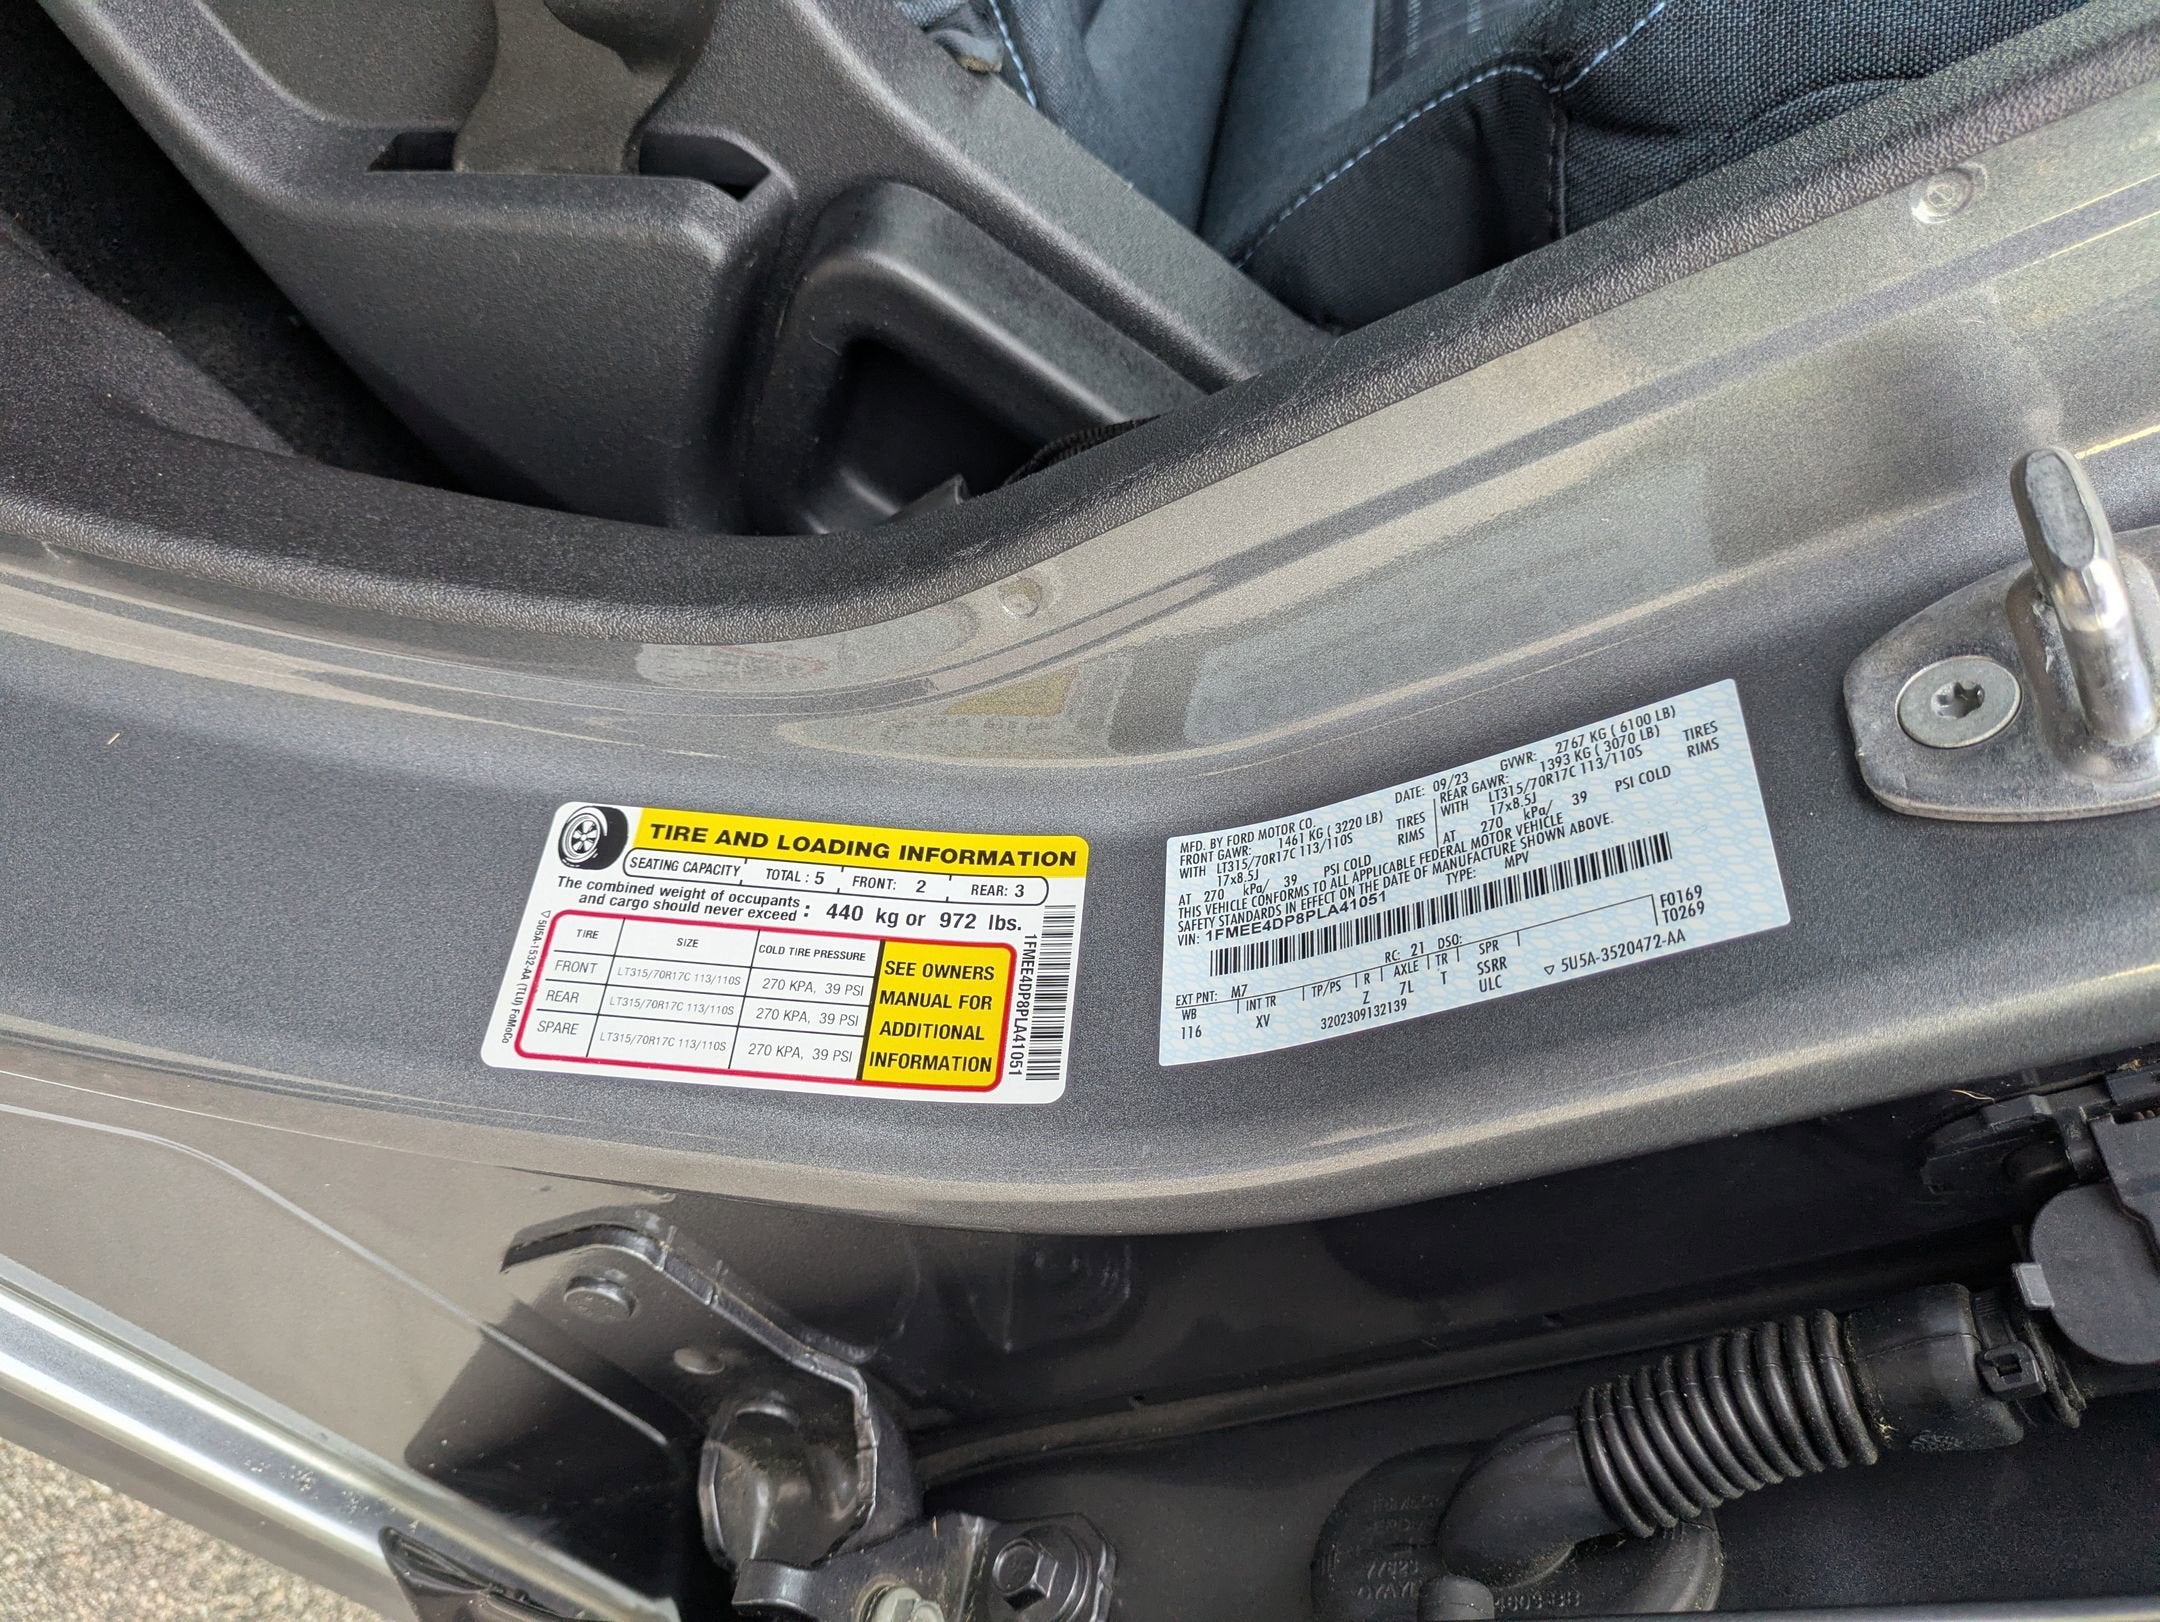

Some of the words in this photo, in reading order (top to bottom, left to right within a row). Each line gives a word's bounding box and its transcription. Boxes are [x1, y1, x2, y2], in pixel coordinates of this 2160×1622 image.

[1500, 752, 1537, 771] GVWR:
[1555, 735, 1585, 754] 2767
[1589, 728, 1607, 742] KG
[1620, 713, 1651, 733] 6100
[1655, 705, 1676, 721] LB)
[1683, 720, 1719, 742] TIRES
[1687, 737, 1720, 758] RIMS
[1440, 786, 1468, 803] REAR
[1472, 774, 1510, 793] GAWR:
[1540, 754, 1571, 772] 1393
[1575, 747, 1591, 761] KG
[1604, 733, 1636, 752] 3070
[1640, 725, 1660, 740] LB)
[1395, 786, 1424, 804] DATE:
[1433, 772, 1469, 792] 09/23
[1440, 799, 1469, 817] WITH
[1488, 766, 1577, 804] LT315/70R17C
[1581, 745, 1643, 774] 113/110S
[1615, 779, 1635, 793] PSI
[1638, 765, 1672, 785] COLD
[1490, 793, 1537, 816] 17x8.5J
[1572, 790, 1588, 806] 39
[1396, 812, 1426, 830] TIRES
[1443, 830, 1456, 844] AT
[1481, 817, 1503, 834] 270
[1523, 800, 1553, 821] kPa/
[650, 824, 708, 842] TIRE
[715, 830, 769, 848] AND
[777, 835, 890, 858] LOADING
[899, 845, 1076, 866] INFORMATION
[1180, 842, 1205, 854] MFD.
[1210, 837, 1223, 848] BY
[1227, 830, 1255, 846] FORD
[1257, 822, 1295, 841] MOTOR
[1299, 818, 1316, 831] CO.
[1180, 849, 1214, 866] FRONT
[1217, 845, 1252, 861] GAWR:
[1279, 834, 1305, 849] 1461
[1309, 827, 1323, 840] KG
[1335, 817, 1362, 834] 3220
[1366, 811, 1383, 825] LB)
[1398, 827, 1425, 846] RIMS
[1179, 865, 1206, 879] WITH
[1217, 847, 1296, 874] LT315/70R17C
[1300, 832, 1353, 856] 113/110S
[1504, 851, 1529, 869] MPV
[630, 856, 679, 872] SEATING
[683, 861, 741, 877] CAPACITY
[1178, 917, 1215, 933] SAFETY
[1219, 905, 1282, 927] STANDARDS
[1301, 891, 1336, 911] EFFECT
[1339, 885, 1355, 900] ON
[1359, 881, 1380, 896] THE
[1383, 867, 1411, 887] DATE
[1432, 839, 1517, 875] MANUFACTURE
[1520, 826, 1566, 848] SHOWN
[1570, 812, 1615, 836] ABOVE.
[1179, 905, 1202, 919] THIS
[1205, 898, 1247, 916] VEHICLE
[1252, 886, 1310, 907] CONFORMS
[1313, 881, 1326, 893] TO
[1330, 874, 1349, 890] ALL
[1352, 854, 1416, 882] APPLICABLE
[1419, 841, 1467, 864] FEDERAL
[1470, 828, 1512, 849] MOTOR
[1515, 812, 1564, 837] VEHICLE
[1323, 864, 1340, 877] PSI
[1344, 855, 1371, 872] COLD
[814, 872, 824, 885] 5
[852, 875, 897, 890] FRONT:
[916, 880, 926, 893] 2
[1217, 869, 1259, 887] 17x8.5J
[1284, 874, 1298, 888] 39
[1446, 867, 1476, 885] TYPE:
[557, 875, 582, 889] The
[586, 879, 655, 895] combined
[659, 886, 706, 901] weight
[710, 889, 726, 901] of
[728, 892, 800, 909] occupants
[971, 884, 1008, 896] REAR:
[1015, 884, 1024, 898] 3
[1179, 893, 1192, 906] AT
[1204, 889, 1225, 902] 270
[1243, 879, 1270, 896] kPa/
[579, 892, 605, 905] and
[609, 897, 649, 911] cargo
[652, 899, 701, 913] should
[704, 905, 744, 917] never
[747, 907, 797, 922] exceed
[826, 903, 864, 921] 440
[876, 908, 899, 928] kg
[905, 913, 926, 926] or
[939, 912, 976, 929] 972
[988, 915, 1022, 931] lbs.
[1178, 934, 1200, 947] VIN:
[1206, 891, 1387, 942] 1FMEE4DP8PLA41051
[576, 929, 599, 939] TIRE
[676, 938, 699, 948] SIZE
[759, 945, 786, 955] COLD
[788, 948, 811, 957] TIRE
[813, 949, 866, 961] PRESSURE
[1479, 940, 1500, 955] SPR
[1561, 929, 1686, 973] 5U5A-3520472-AA
[554, 960, 598, 974] FRONT
[1393, 960, 1419, 978] AXLE
[1436, 954, 1449, 966] TR
[1476, 956, 1508, 975] SSRR
[617, 967, 691, 982] LT315/70R17C
[693, 972, 741, 986] 113/110S
[884, 960, 916, 977] SEE
[922, 963, 995, 980] OWNERS
[762, 978, 786, 990] 270
[789, 980, 816, 994] KPA,
[825, 983, 841, 994] 39
[844, 984, 864, 996] PSI
[1312, 981, 1342, 998] TP/PS
[1479, 976, 1503, 992] ULC
[546, 990, 579, 1004] REAR
[879, 990, 952, 1008] MANUAL
[958, 995, 993, 1010] FOR
[1176, 994, 1193, 1006] EXT
[1196, 990, 1217, 1004] PNT:
[1231, 984, 1248, 998] M7
[1246, 999, 1263, 1011] INT
[1266, 996, 1277, 1007] TR
[610, 997, 684, 1011] LT315/70R17C
[687, 1002, 735, 1016] 113/110S
[1008, 934, 1037, 1076] 1FMEE4DP8PLA41051
[1182, 1009, 1198, 1020] WB
[1320, 998, 1408, 1030] 3202309132139
[756, 1008, 780, 1020] 270
[783, 1010, 811, 1024] KPA,
[819, 1013, 836, 1025] 39
[839, 1015, 859, 1026] PSI
[1256, 1014, 1271, 1028] XV
[502, 1009, 520, 1043] FoMoCo
[537, 1021, 580, 1035] SPARE
[879, 1021, 984, 1041] ADDITIONAL
[1181, 1026, 1202, 1039] 116
[600, 1032, 676, 1047] LT315/70R17C
[679, 1038, 727, 1052] 113/110S
[748, 1043, 772, 1056] 270
[776, 1046, 804, 1059] KPA,
[812, 1049, 829, 1060] 39
[832, 1050, 853, 1062] PSI
[869, 1051, 992, 1072] INFORMATION
